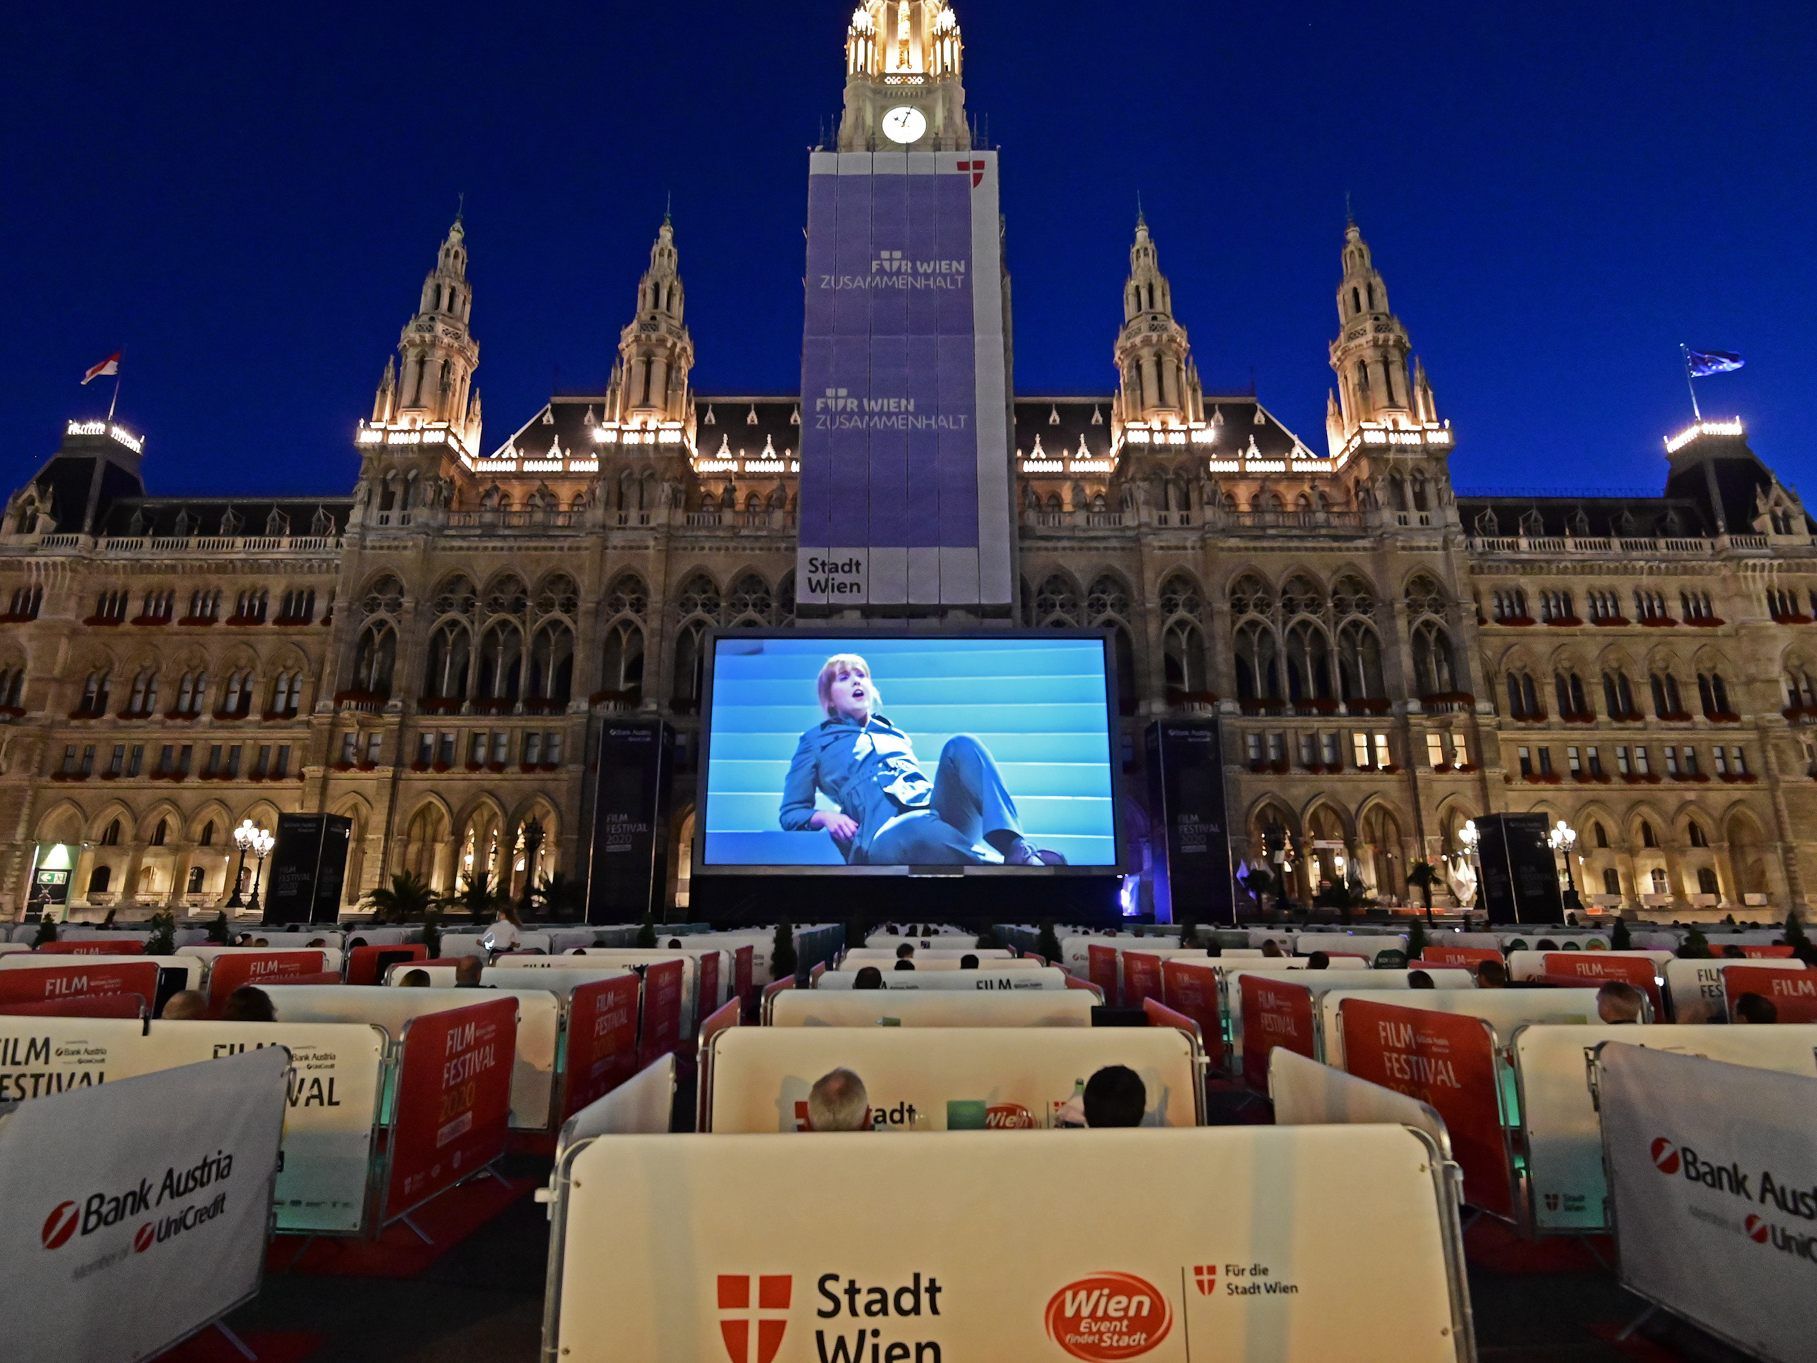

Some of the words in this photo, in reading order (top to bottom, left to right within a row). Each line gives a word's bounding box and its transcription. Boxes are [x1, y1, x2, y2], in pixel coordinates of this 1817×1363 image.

[916, 260, 965, 273] WIEN
[820, 275, 964, 289] ZUSAMMENHALT
[863, 398, 915, 412] WIEN
[815, 414, 968, 430] ZUSAMMENHALT
[808, 557, 862, 574] Stadt
[807, 577, 861, 594] Wien
[606, 823, 649, 834] FESTIVAL
[250, 959, 278, 975] FILM
[1575, 963, 1604, 976] FILM
[45, 975, 88, 996] FILM
[1771, 979, 1816, 996] FILM
[446, 1021, 475, 1056] FILM
[1378, 1020, 1416, 1049] FILM
[0, 1037, 50, 1066] ILM
[442, 1042, 496, 1090] FESTIVAL
[1383, 1051, 1462, 1089] FESTIVAL
[1680, 1146, 1752, 1201] Bank
[1760, 1171, 1817, 1220] Aus
[81, 1178, 154, 1236] Bank
[155, 1150, 233, 1207] Austria
[157, 1192, 227, 1243] UniCredit
[1225, 1264, 1246, 1276] Für
[1249, 1264, 1269, 1276] die
[816, 1271, 943, 1319] Stadt
[1226, 1282, 1261, 1296] Stadt
[1263, 1282, 1299, 1295] Wien
[1063, 1288, 1151, 1318] Wien
[1079, 1318, 1129, 1333] Event
[815, 1328, 942, 1363] Wien
[1065, 1333, 1099, 1345] findet
[1099, 1332, 1148, 1347] Stadt
